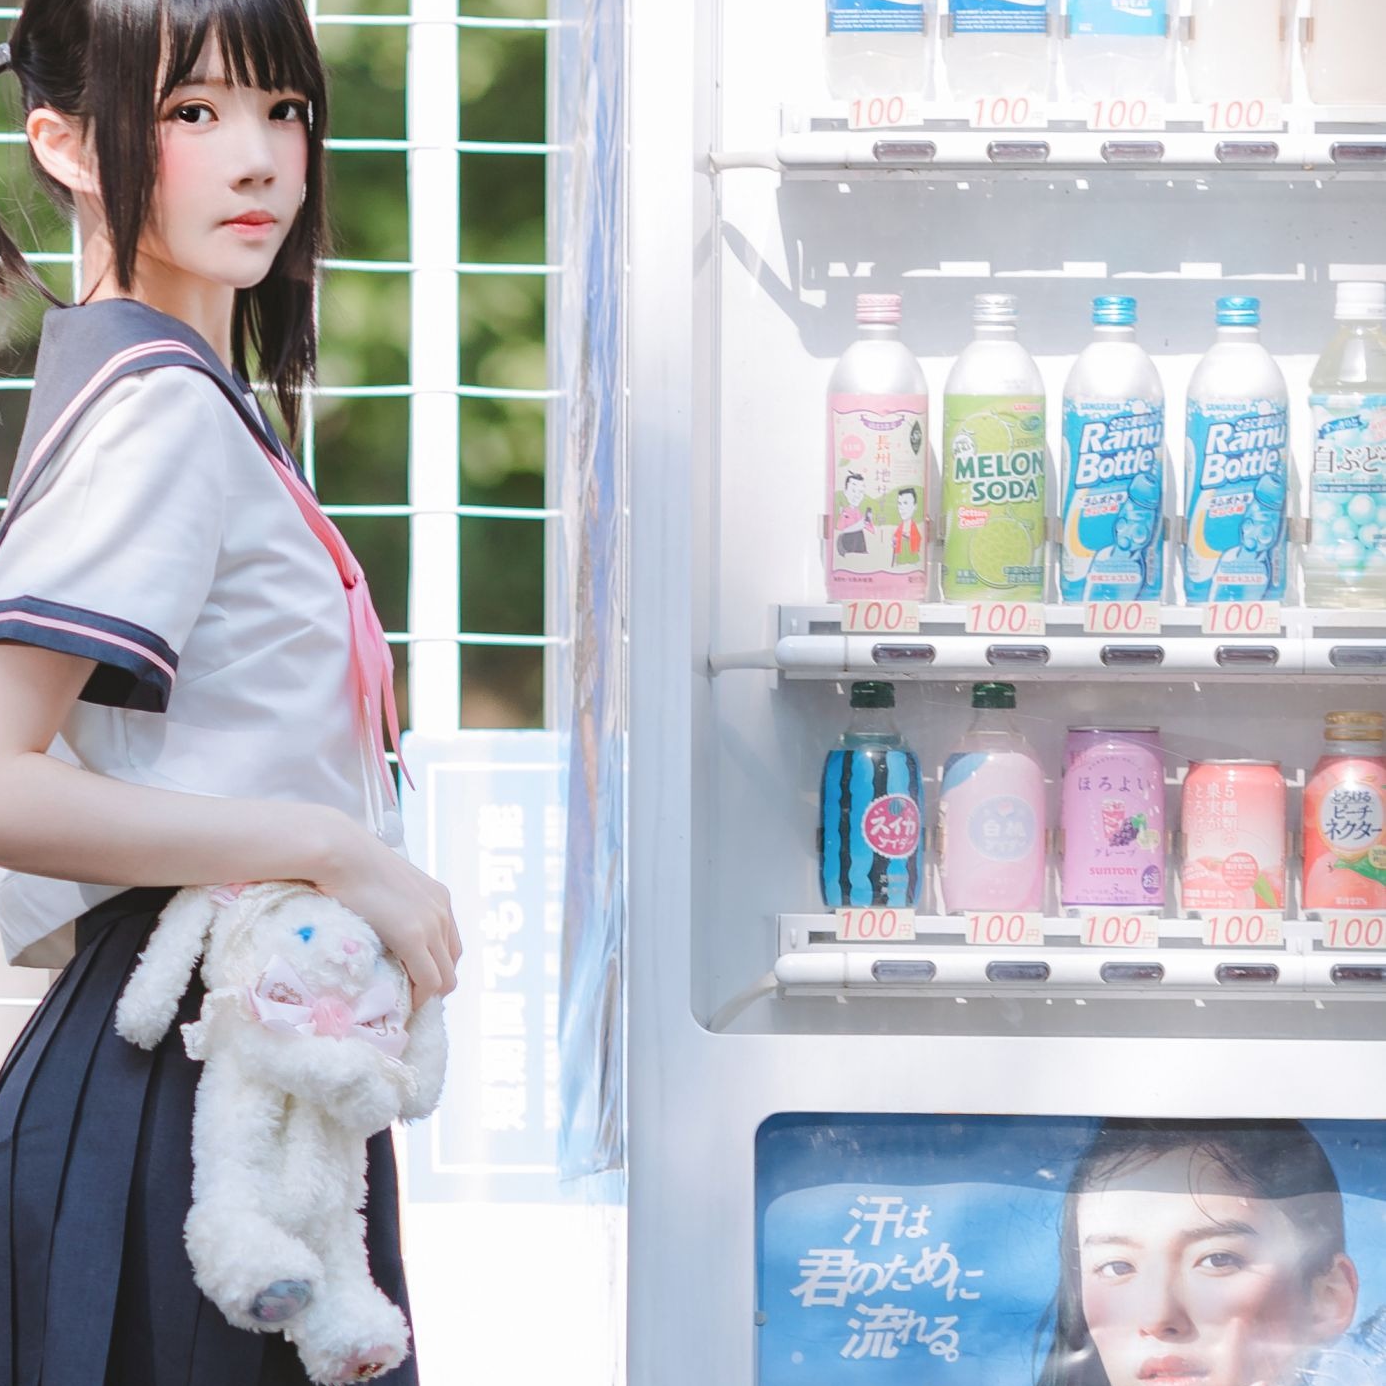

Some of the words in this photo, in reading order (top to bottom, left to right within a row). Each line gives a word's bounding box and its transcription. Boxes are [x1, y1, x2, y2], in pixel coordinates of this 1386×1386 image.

[1080, 421, 1162, 454] Ramu
[1205, 421, 1286, 455] Ramu
[954, 450, 1045, 481] MELON
[1075, 448, 1155, 488] Bottle
[1201, 449, 1280, 489] Bottle
[1314, 445, 1386, 474] 白ぶど
[972, 480, 1038, 503] SODA
[869, 815, 916, 837] スイカ
[1325, 818, 1383, 841] ネクター
[842, 1194, 933, 1246] 汗は
[790, 1242, 984, 1308] 君のために
